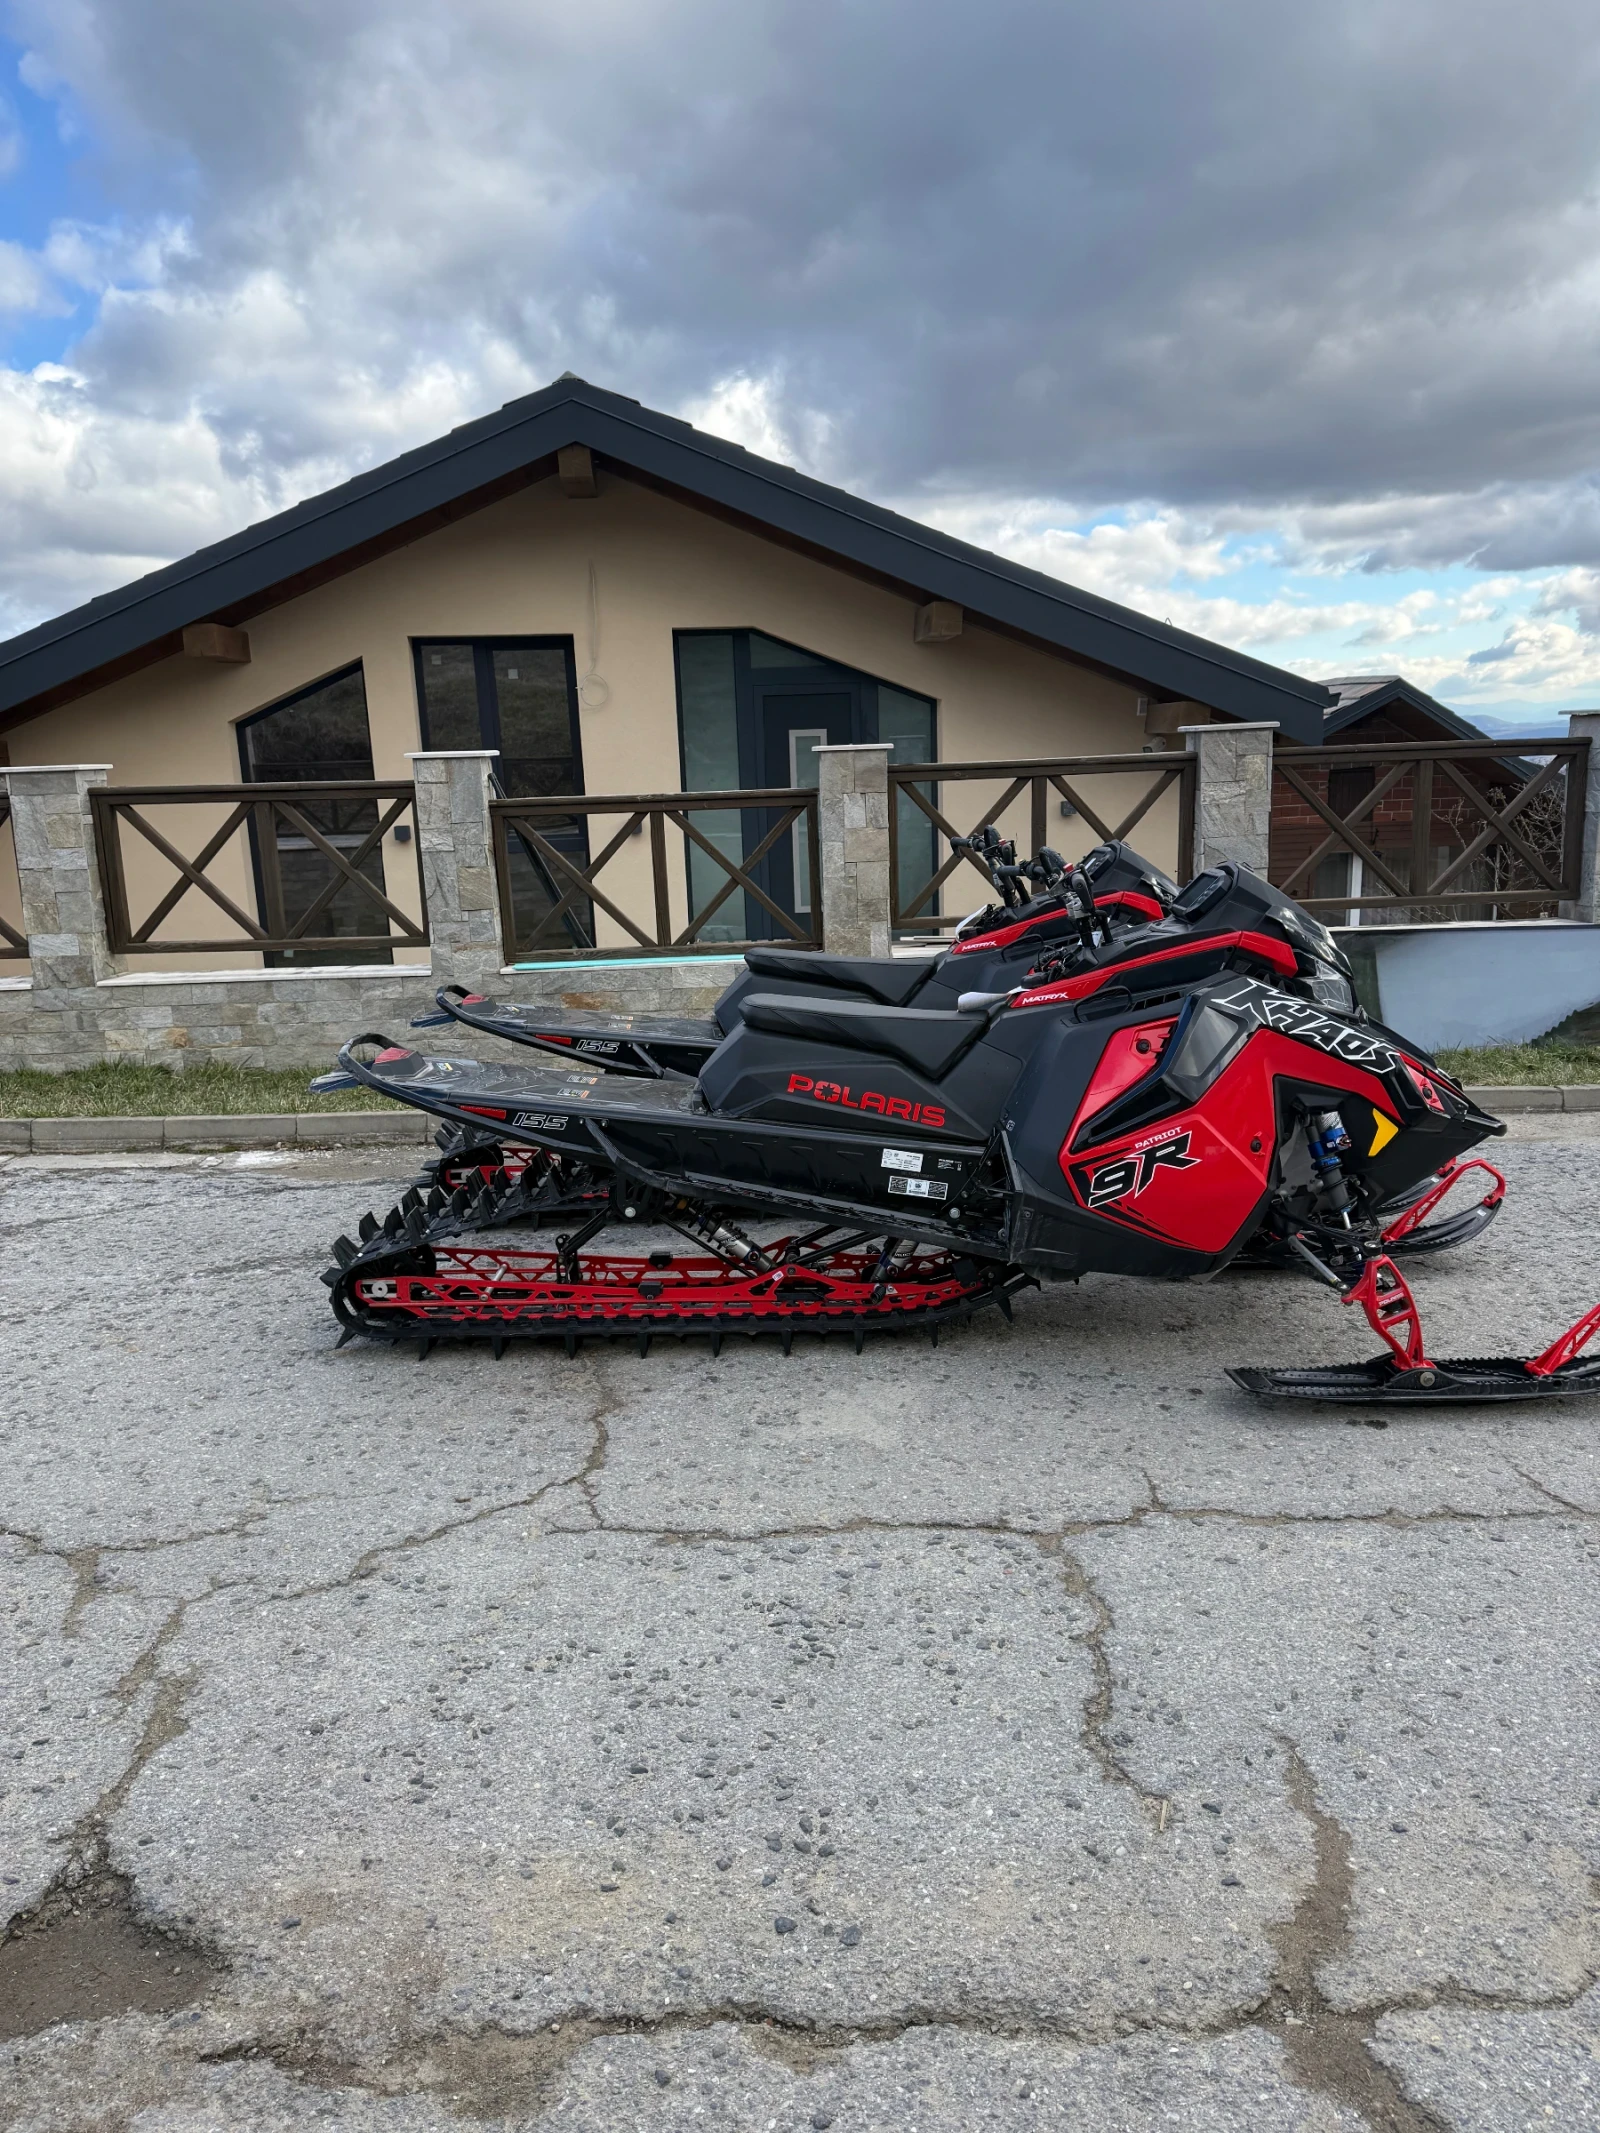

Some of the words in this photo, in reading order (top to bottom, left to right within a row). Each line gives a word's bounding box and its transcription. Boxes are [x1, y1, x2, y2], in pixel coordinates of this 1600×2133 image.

[962, 940, 997, 952] MATRYX
[1022, 991, 1069, 1005] MATRYX
[1211, 978, 1401, 1074] KHAOS
[576, 1040, 620, 1053] 155
[787, 1073, 946, 1128] POLARIS
[512, 1112, 569, 1131] 155
[1134, 1126, 1182, 1149] PATRIOT
